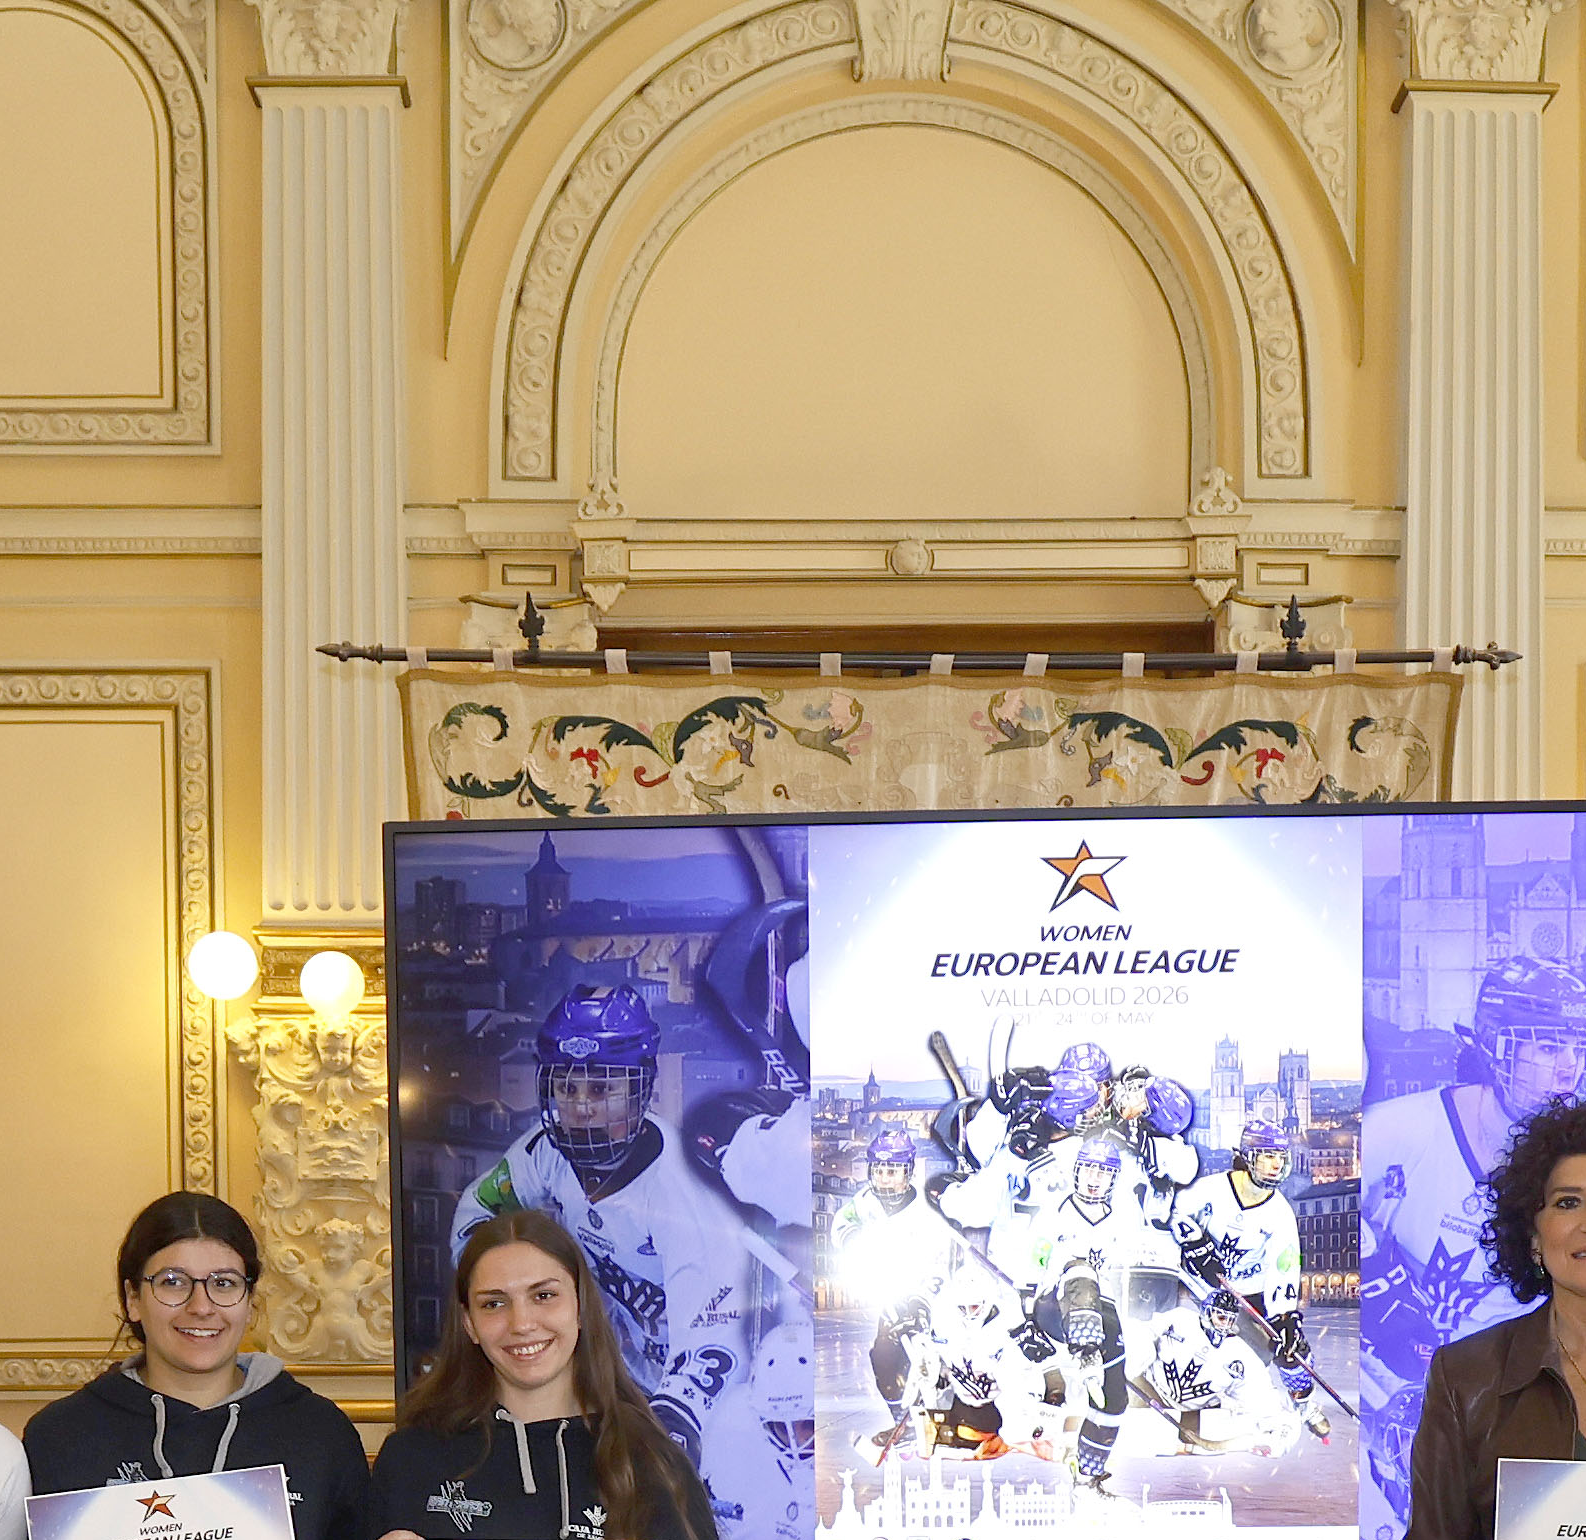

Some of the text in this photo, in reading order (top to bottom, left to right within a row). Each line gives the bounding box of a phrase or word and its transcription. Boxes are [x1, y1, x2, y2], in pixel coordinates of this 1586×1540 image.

[1040, 925, 1132, 941] WOMEN
[931, 949, 1240, 977] EUROPEAN LEAGUE
[980, 986, 1189, 1006] VALLADOLID 2026
[1118, 1011, 1155, 1024] MAY
[139, 1523, 183, 1536] WOMEN
